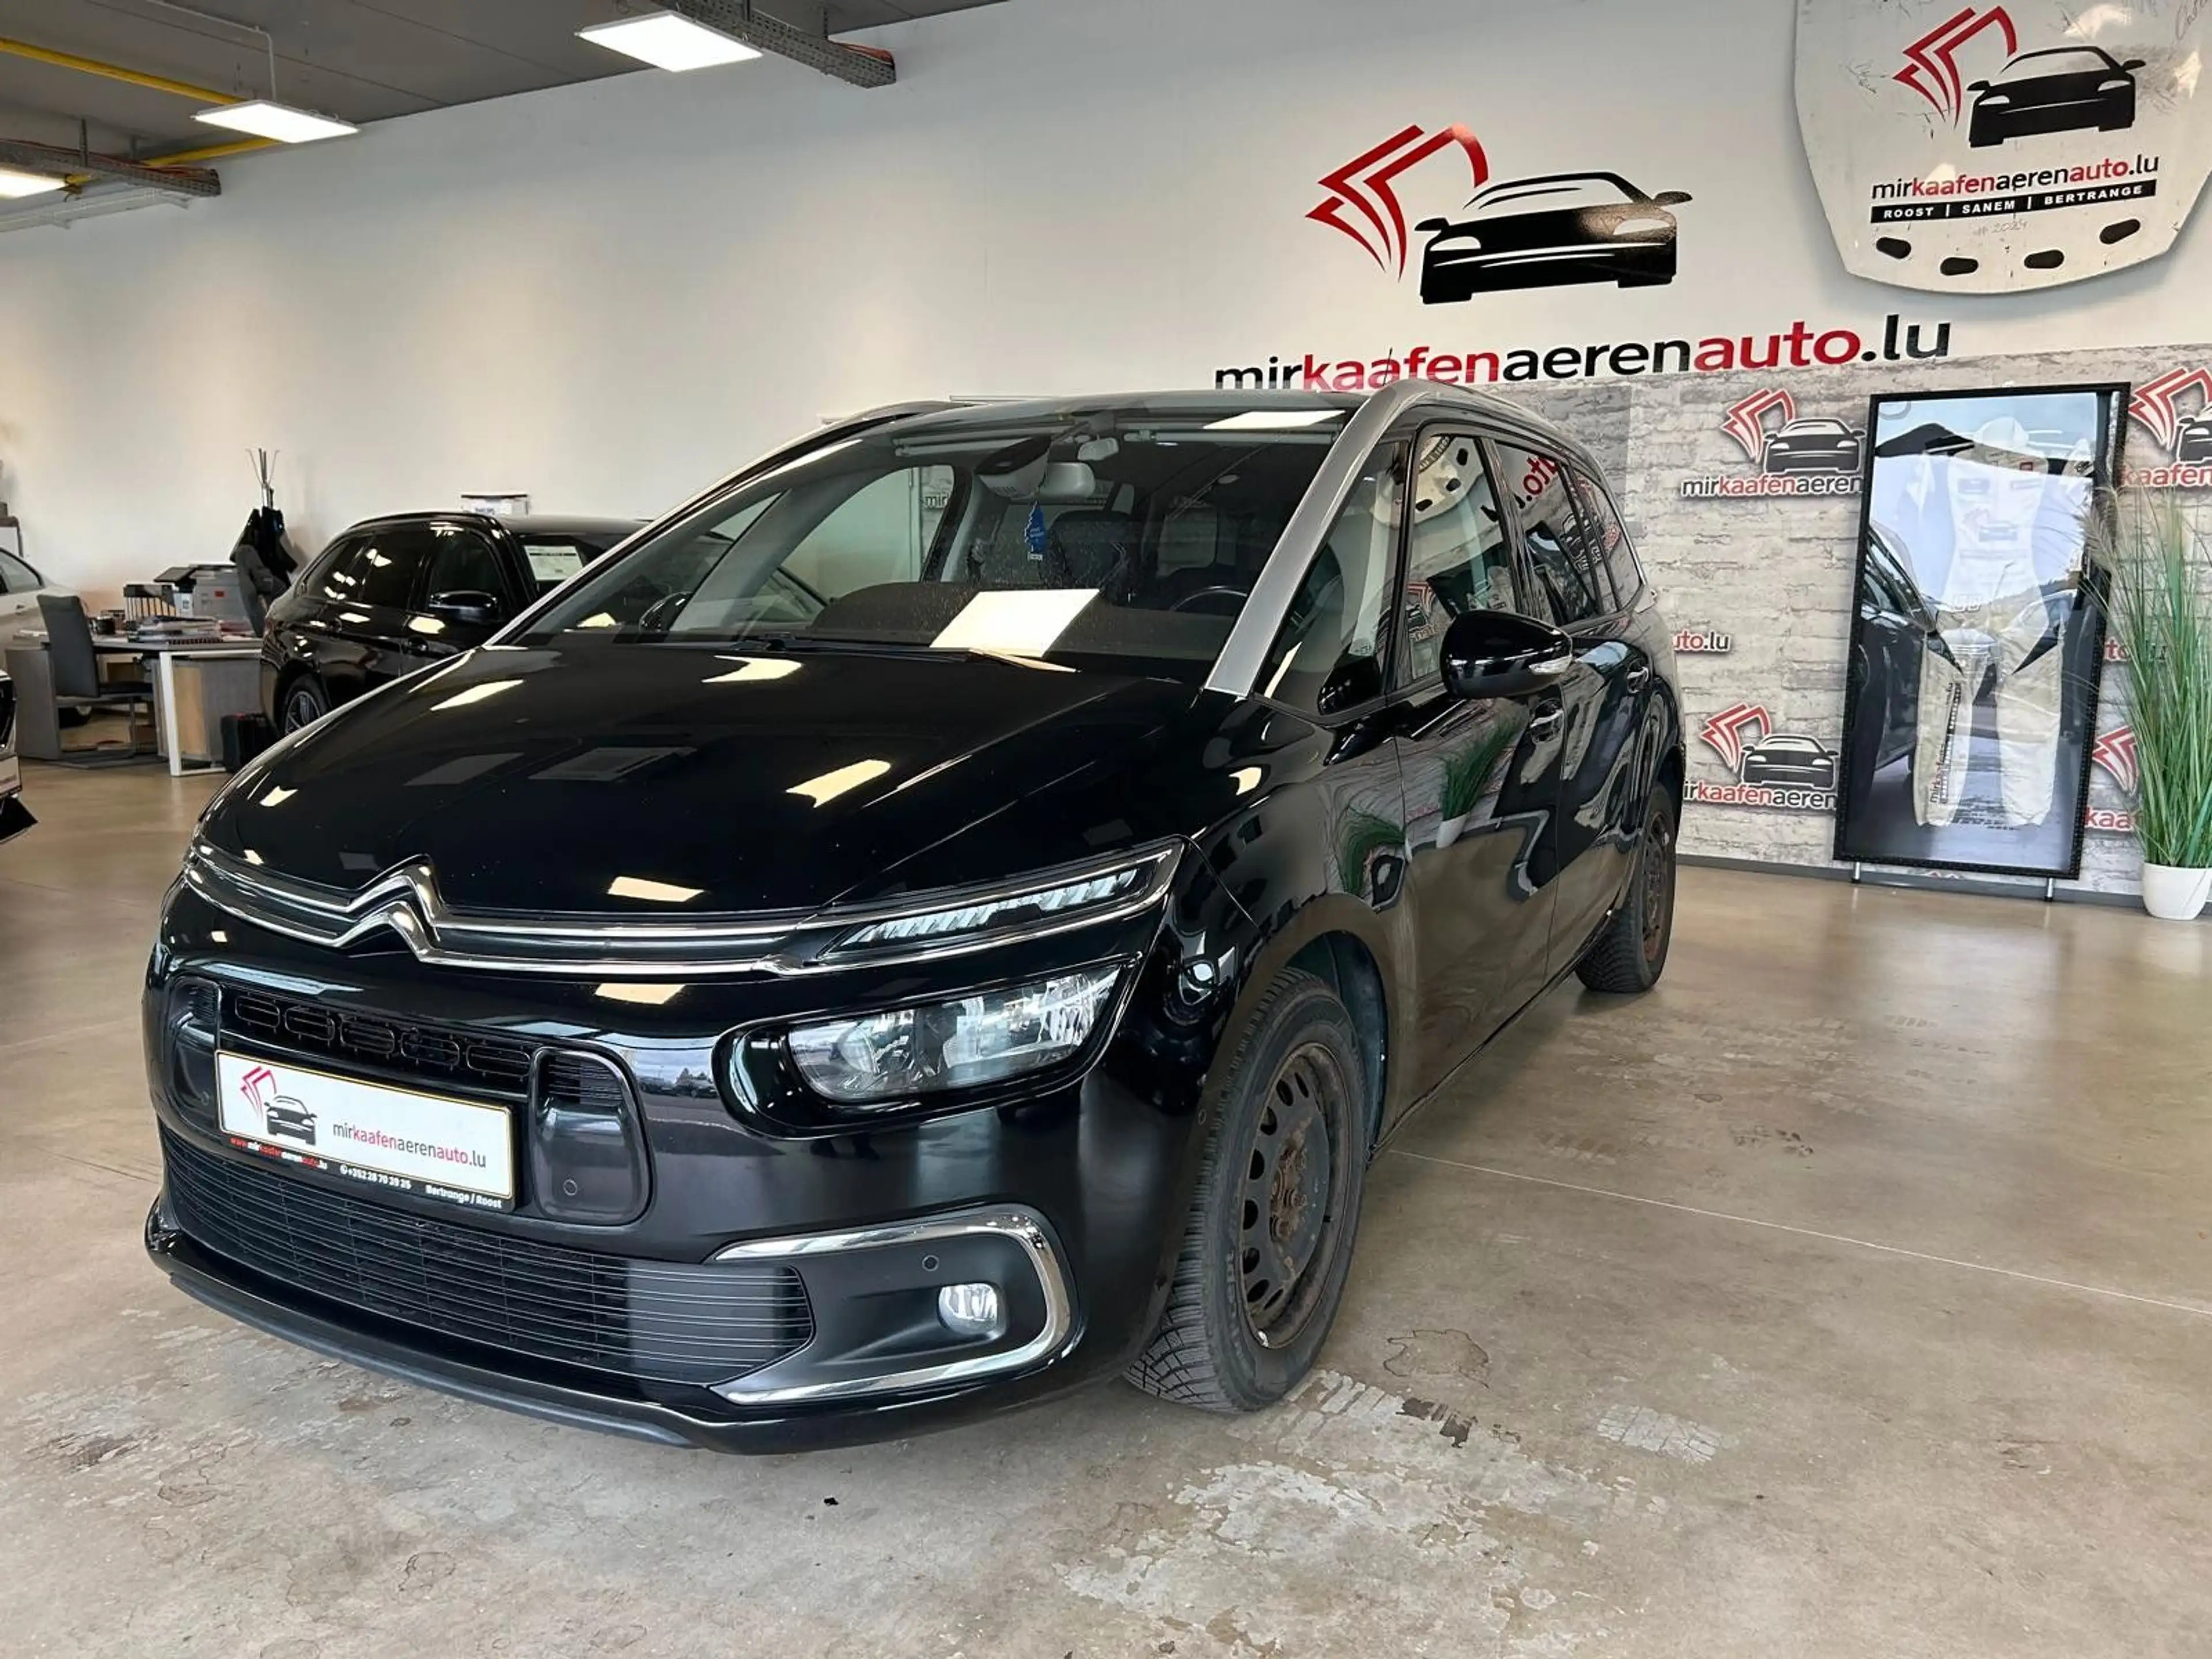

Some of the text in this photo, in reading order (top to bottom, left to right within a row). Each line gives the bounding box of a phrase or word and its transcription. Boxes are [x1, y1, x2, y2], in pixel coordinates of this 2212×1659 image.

[1872, 154, 2159, 199] mirkaafenaerenauto.lu
[1883, 207, 1934, 219] ROOST
[1961, 200, 2015, 214] SANEM
[2044, 185, 2142, 206] BERTRANGE
[1215, 314, 1951, 392] mirkaafenaerenauto.lu
[333, 1122, 486, 1168] mirkaafenaerenauto.lu
[425, 1184, 471, 1205] Bertrange
[476, 1194, 503, 1209] Roost
